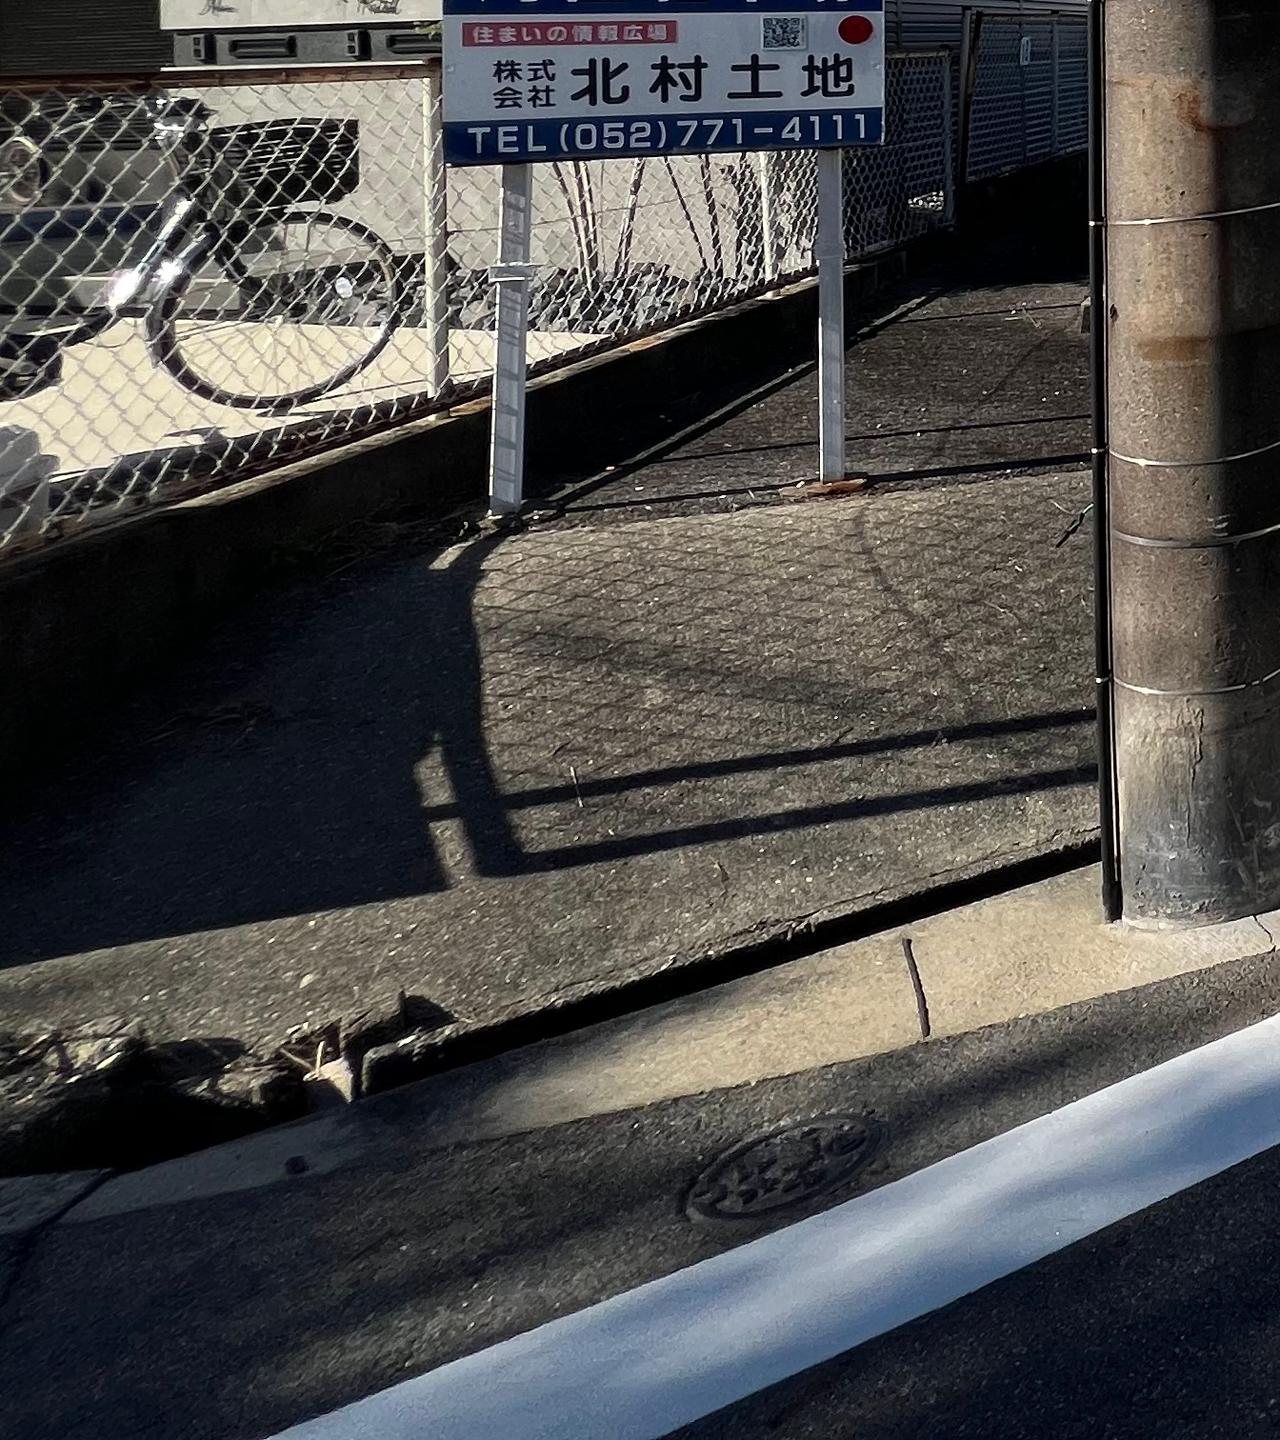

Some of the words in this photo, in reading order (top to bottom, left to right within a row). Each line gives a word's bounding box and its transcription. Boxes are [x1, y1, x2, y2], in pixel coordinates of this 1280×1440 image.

[472, 24, 667, 44] 住まいの情報広場
[570, 53, 855, 107] 北村土地
[467, 125, 546, 154] TEL
[559, 113, 866, 152] (052)771-4111
